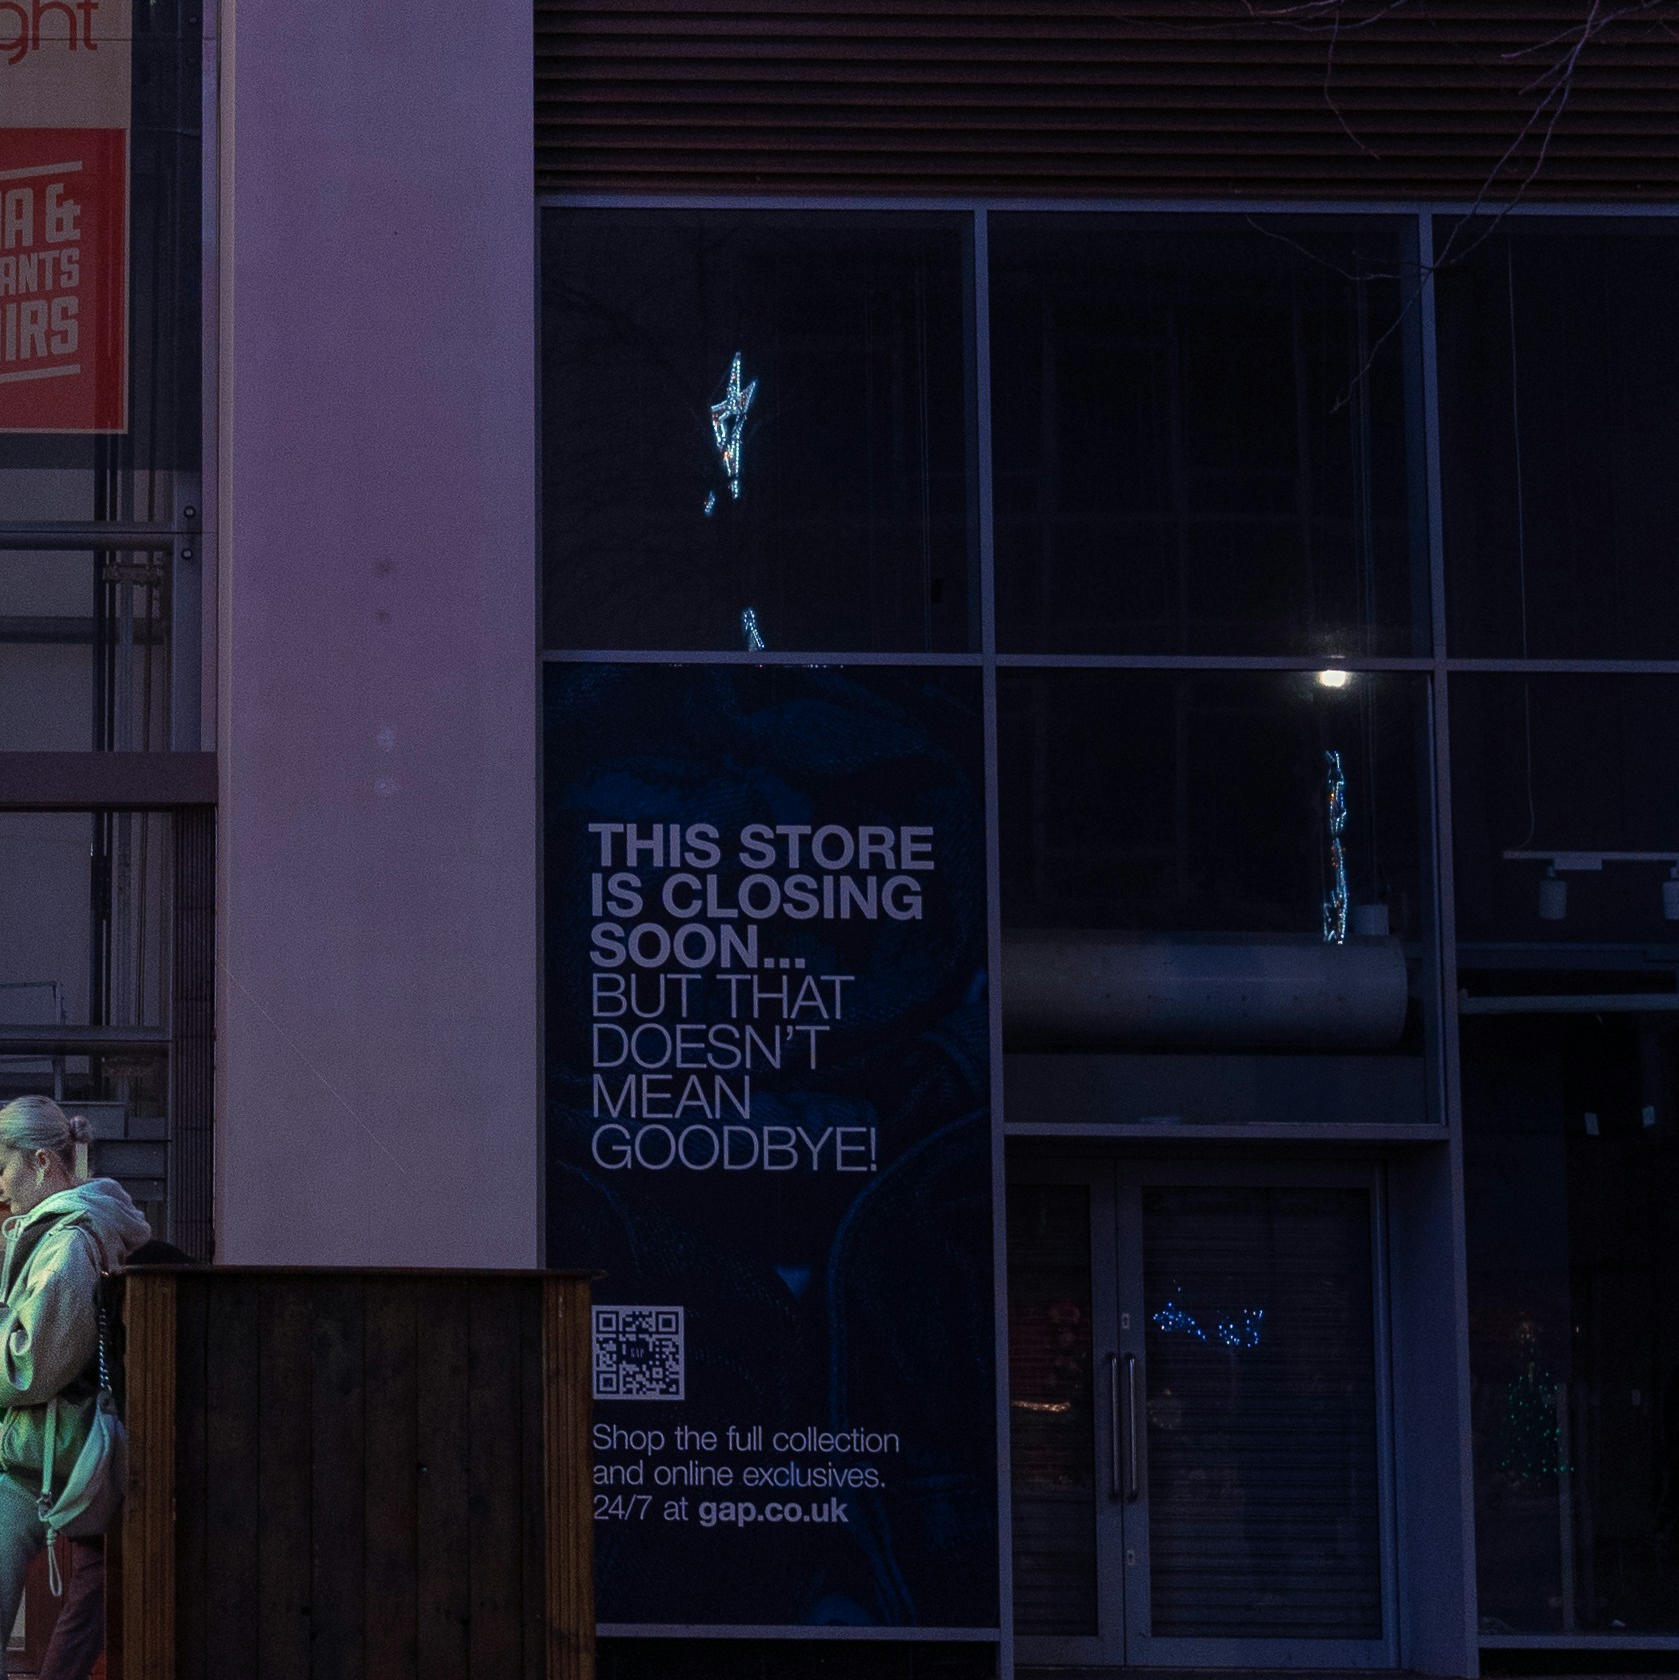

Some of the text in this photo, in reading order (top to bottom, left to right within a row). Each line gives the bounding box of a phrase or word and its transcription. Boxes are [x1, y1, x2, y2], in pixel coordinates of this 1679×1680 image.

[45, 182, 81, 242] &
[588, 823, 935, 870] THIS STORE
[591, 872, 922, 920] IS CLOSING
[589, 922, 806, 969] SOON...
[592, 973, 855, 1020] BUT THAT
[592, 1023, 831, 1070] DOESN'T
[592, 1073, 750, 1120] MEAN
[591, 1124, 878, 1172] GOODBYE!
[592, 1424, 900, 1456] Shop the full collection
[592, 1461, 887, 1489] and online exclusives.
[593, 1495, 850, 1528] 24/7 at gap.co.uk
